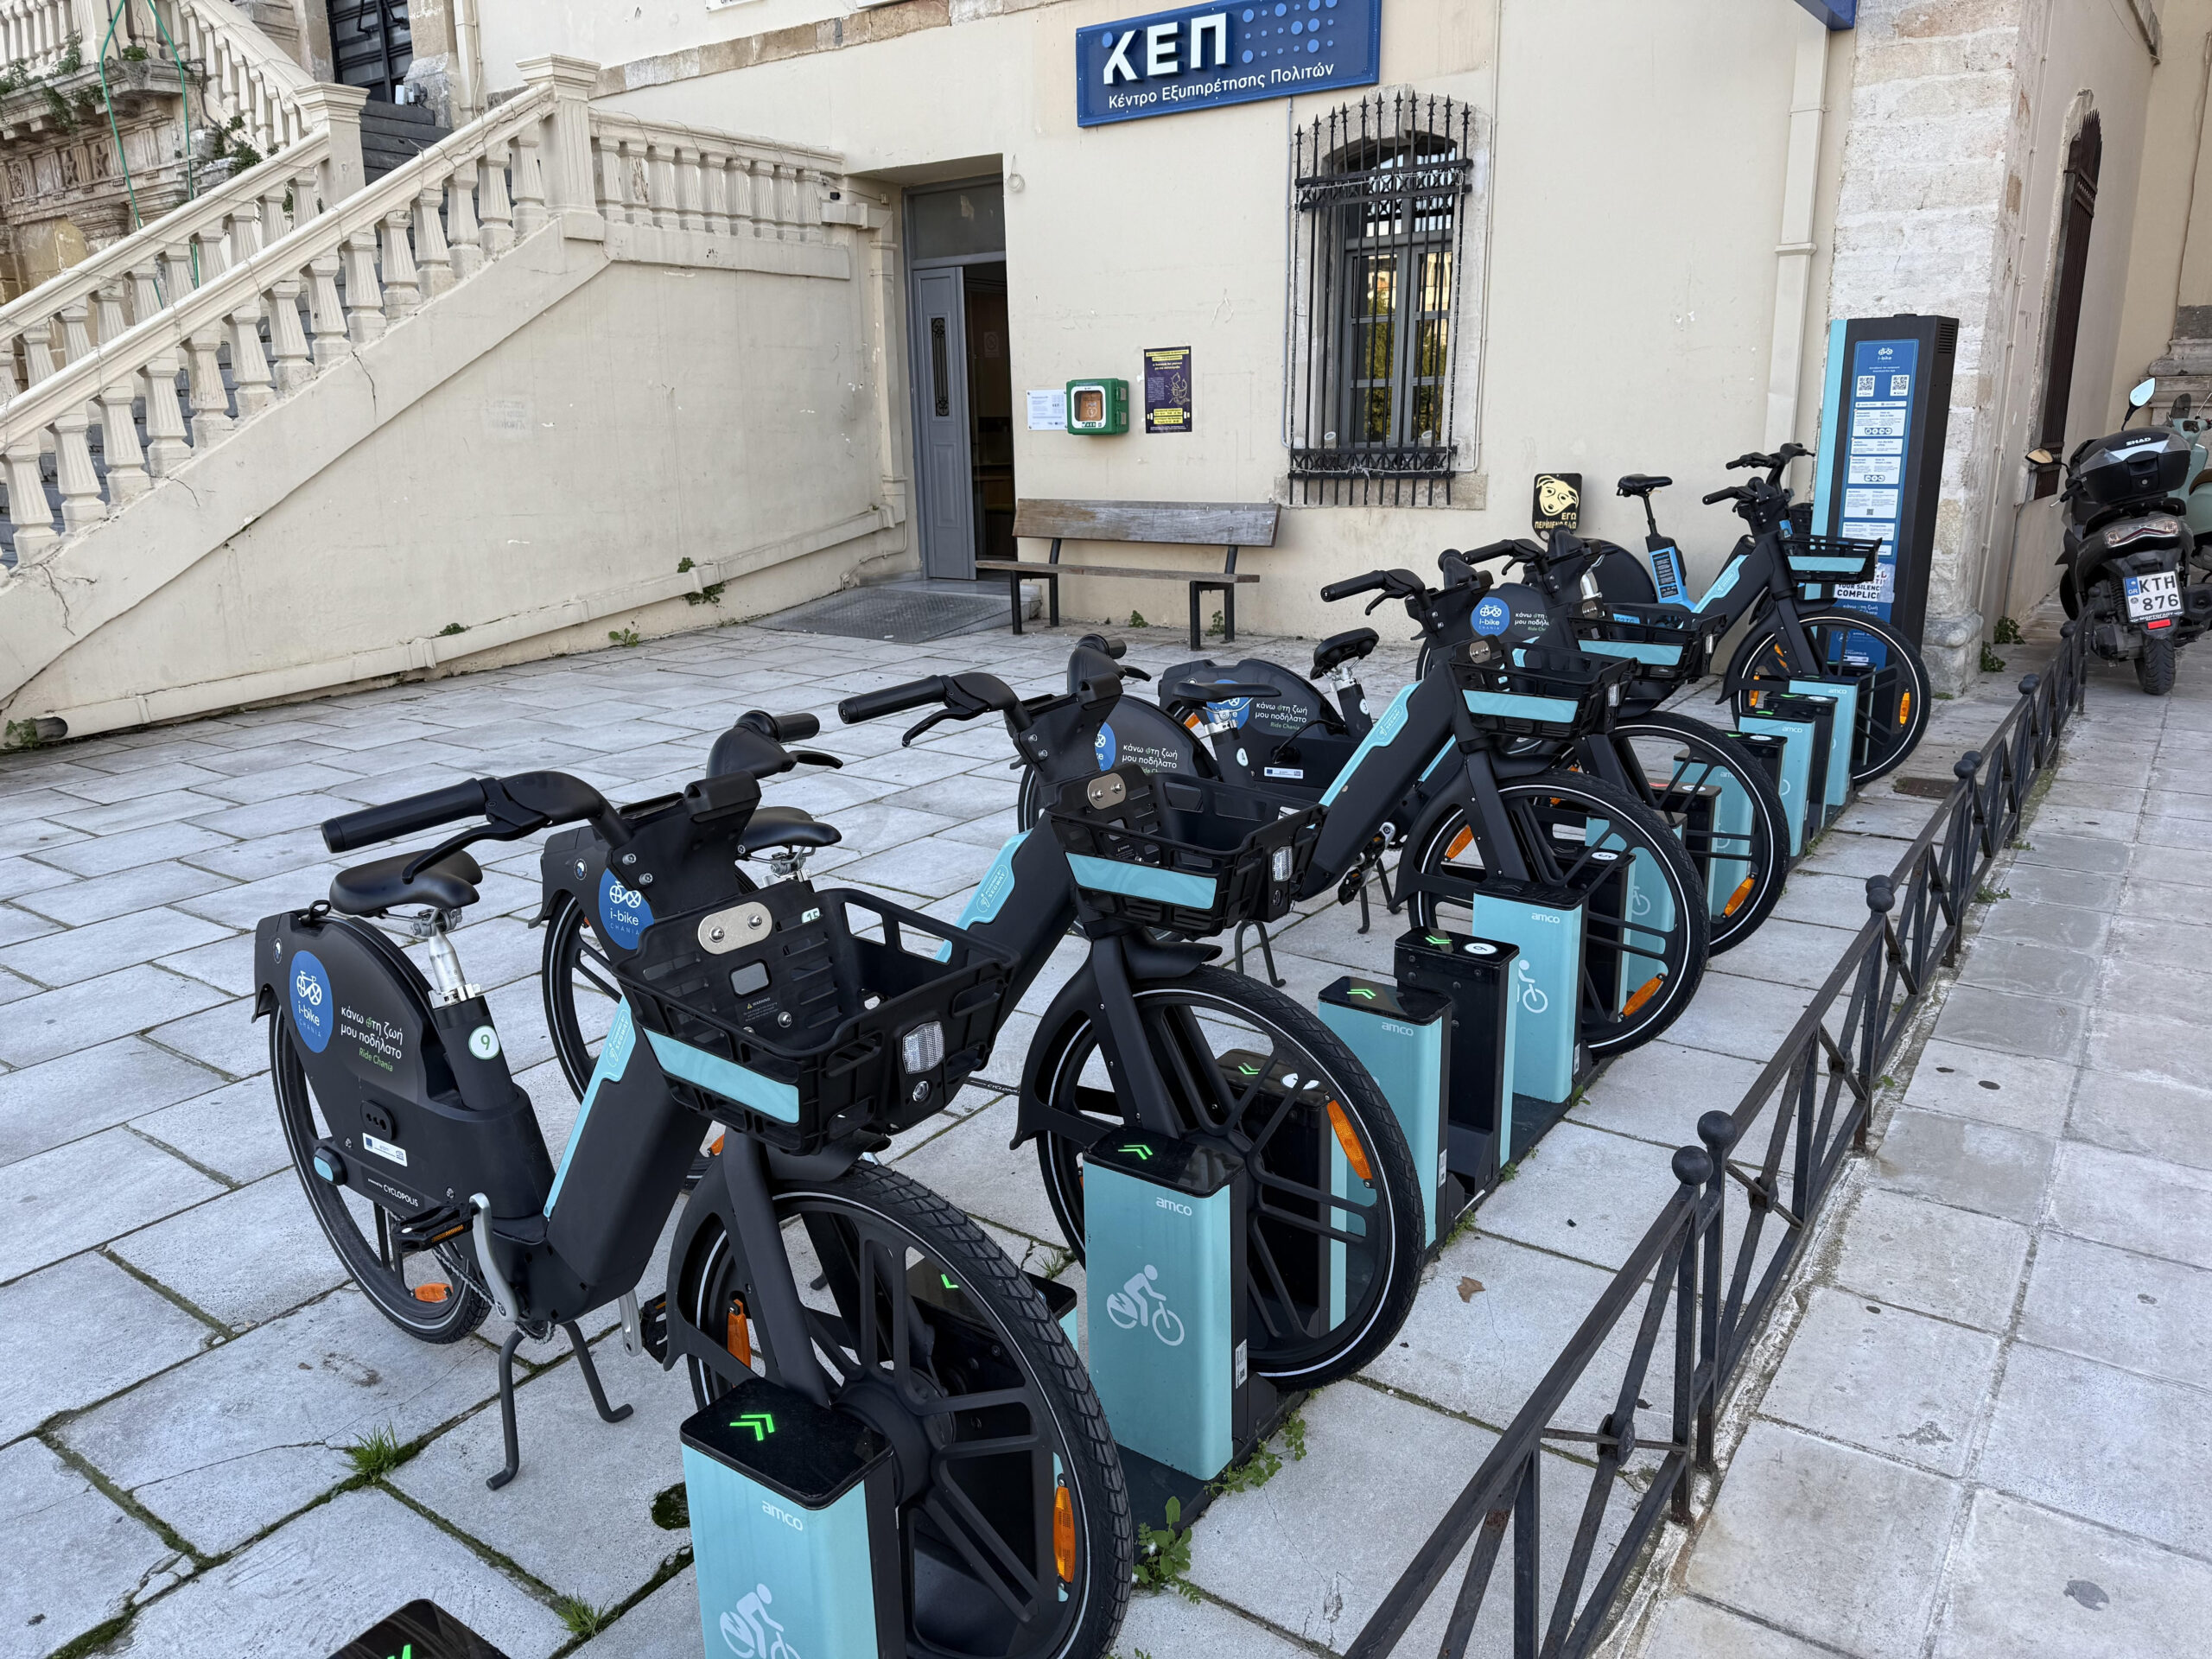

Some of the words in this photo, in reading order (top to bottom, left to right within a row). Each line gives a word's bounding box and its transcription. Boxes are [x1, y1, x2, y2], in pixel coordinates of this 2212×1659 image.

[1103, 12, 1229, 85] ΚΕΠ
[1109, 91, 1157, 109] Κέντρο
[1162, 73, 1266, 102] Εξυπηρέτησης
[1270, 62, 1334, 84] Πολιτών
[2126, 437, 2152, 446] SHAD
[2142, 594, 2178, 611] 876
[1255, 702, 1276, 710] κάνω
[1292, 704, 1308, 716] ζωή
[1270, 713, 1307, 723] ποδήλατο
[1123, 743, 1144, 753] κάνω
[1160, 747, 1179, 760] ζωή
[1122, 754, 1137, 763] μου
[1138, 756, 1177, 769] ποδήλατο
[988, 872, 1005, 899] SEGWAY
[609, 907, 639, 926] i-bike
[1531, 912, 1560, 924] amco
[610, 923, 639, 936] CHANIA
[297, 1001, 321, 1027] i-bike
[298, 1018, 321, 1038] CHANIA
[340, 1006, 365, 1024] κάνω
[383, 1021, 404, 1046] ζωή
[1381, 1021, 1414, 1037] amco
[340, 1023, 358, 1039] μου
[359, 1032, 402, 1059] ποδήλατο
[480, 1033, 491, 1051] 9
[359, 1047, 372, 1061] Ride
[372, 1054, 393, 1072] Chania
[383, 1184, 419, 1207] CYCLOPOLIS
[1155, 1197, 1192, 1217] amco
[761, 1500, 804, 1531] amco
